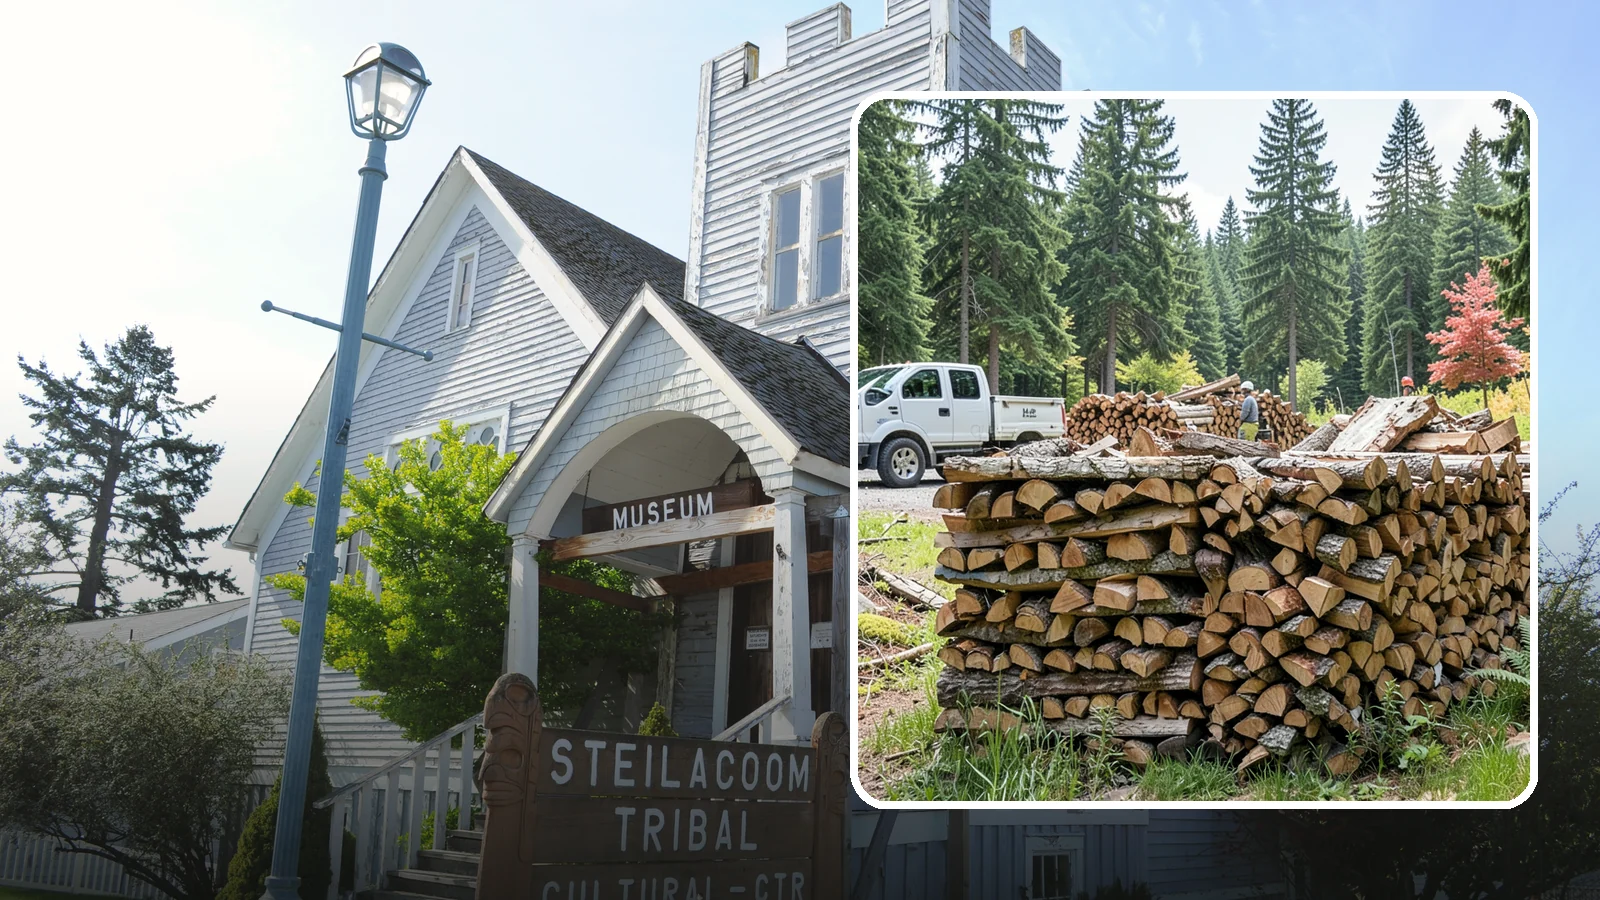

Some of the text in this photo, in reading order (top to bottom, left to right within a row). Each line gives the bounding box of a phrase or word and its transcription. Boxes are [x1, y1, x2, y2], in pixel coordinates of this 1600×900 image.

[613, 492, 713, 531] MUSEUM
[550, 738, 810, 793] STEILACOOM
[615, 806, 758, 852] TRIBAL
